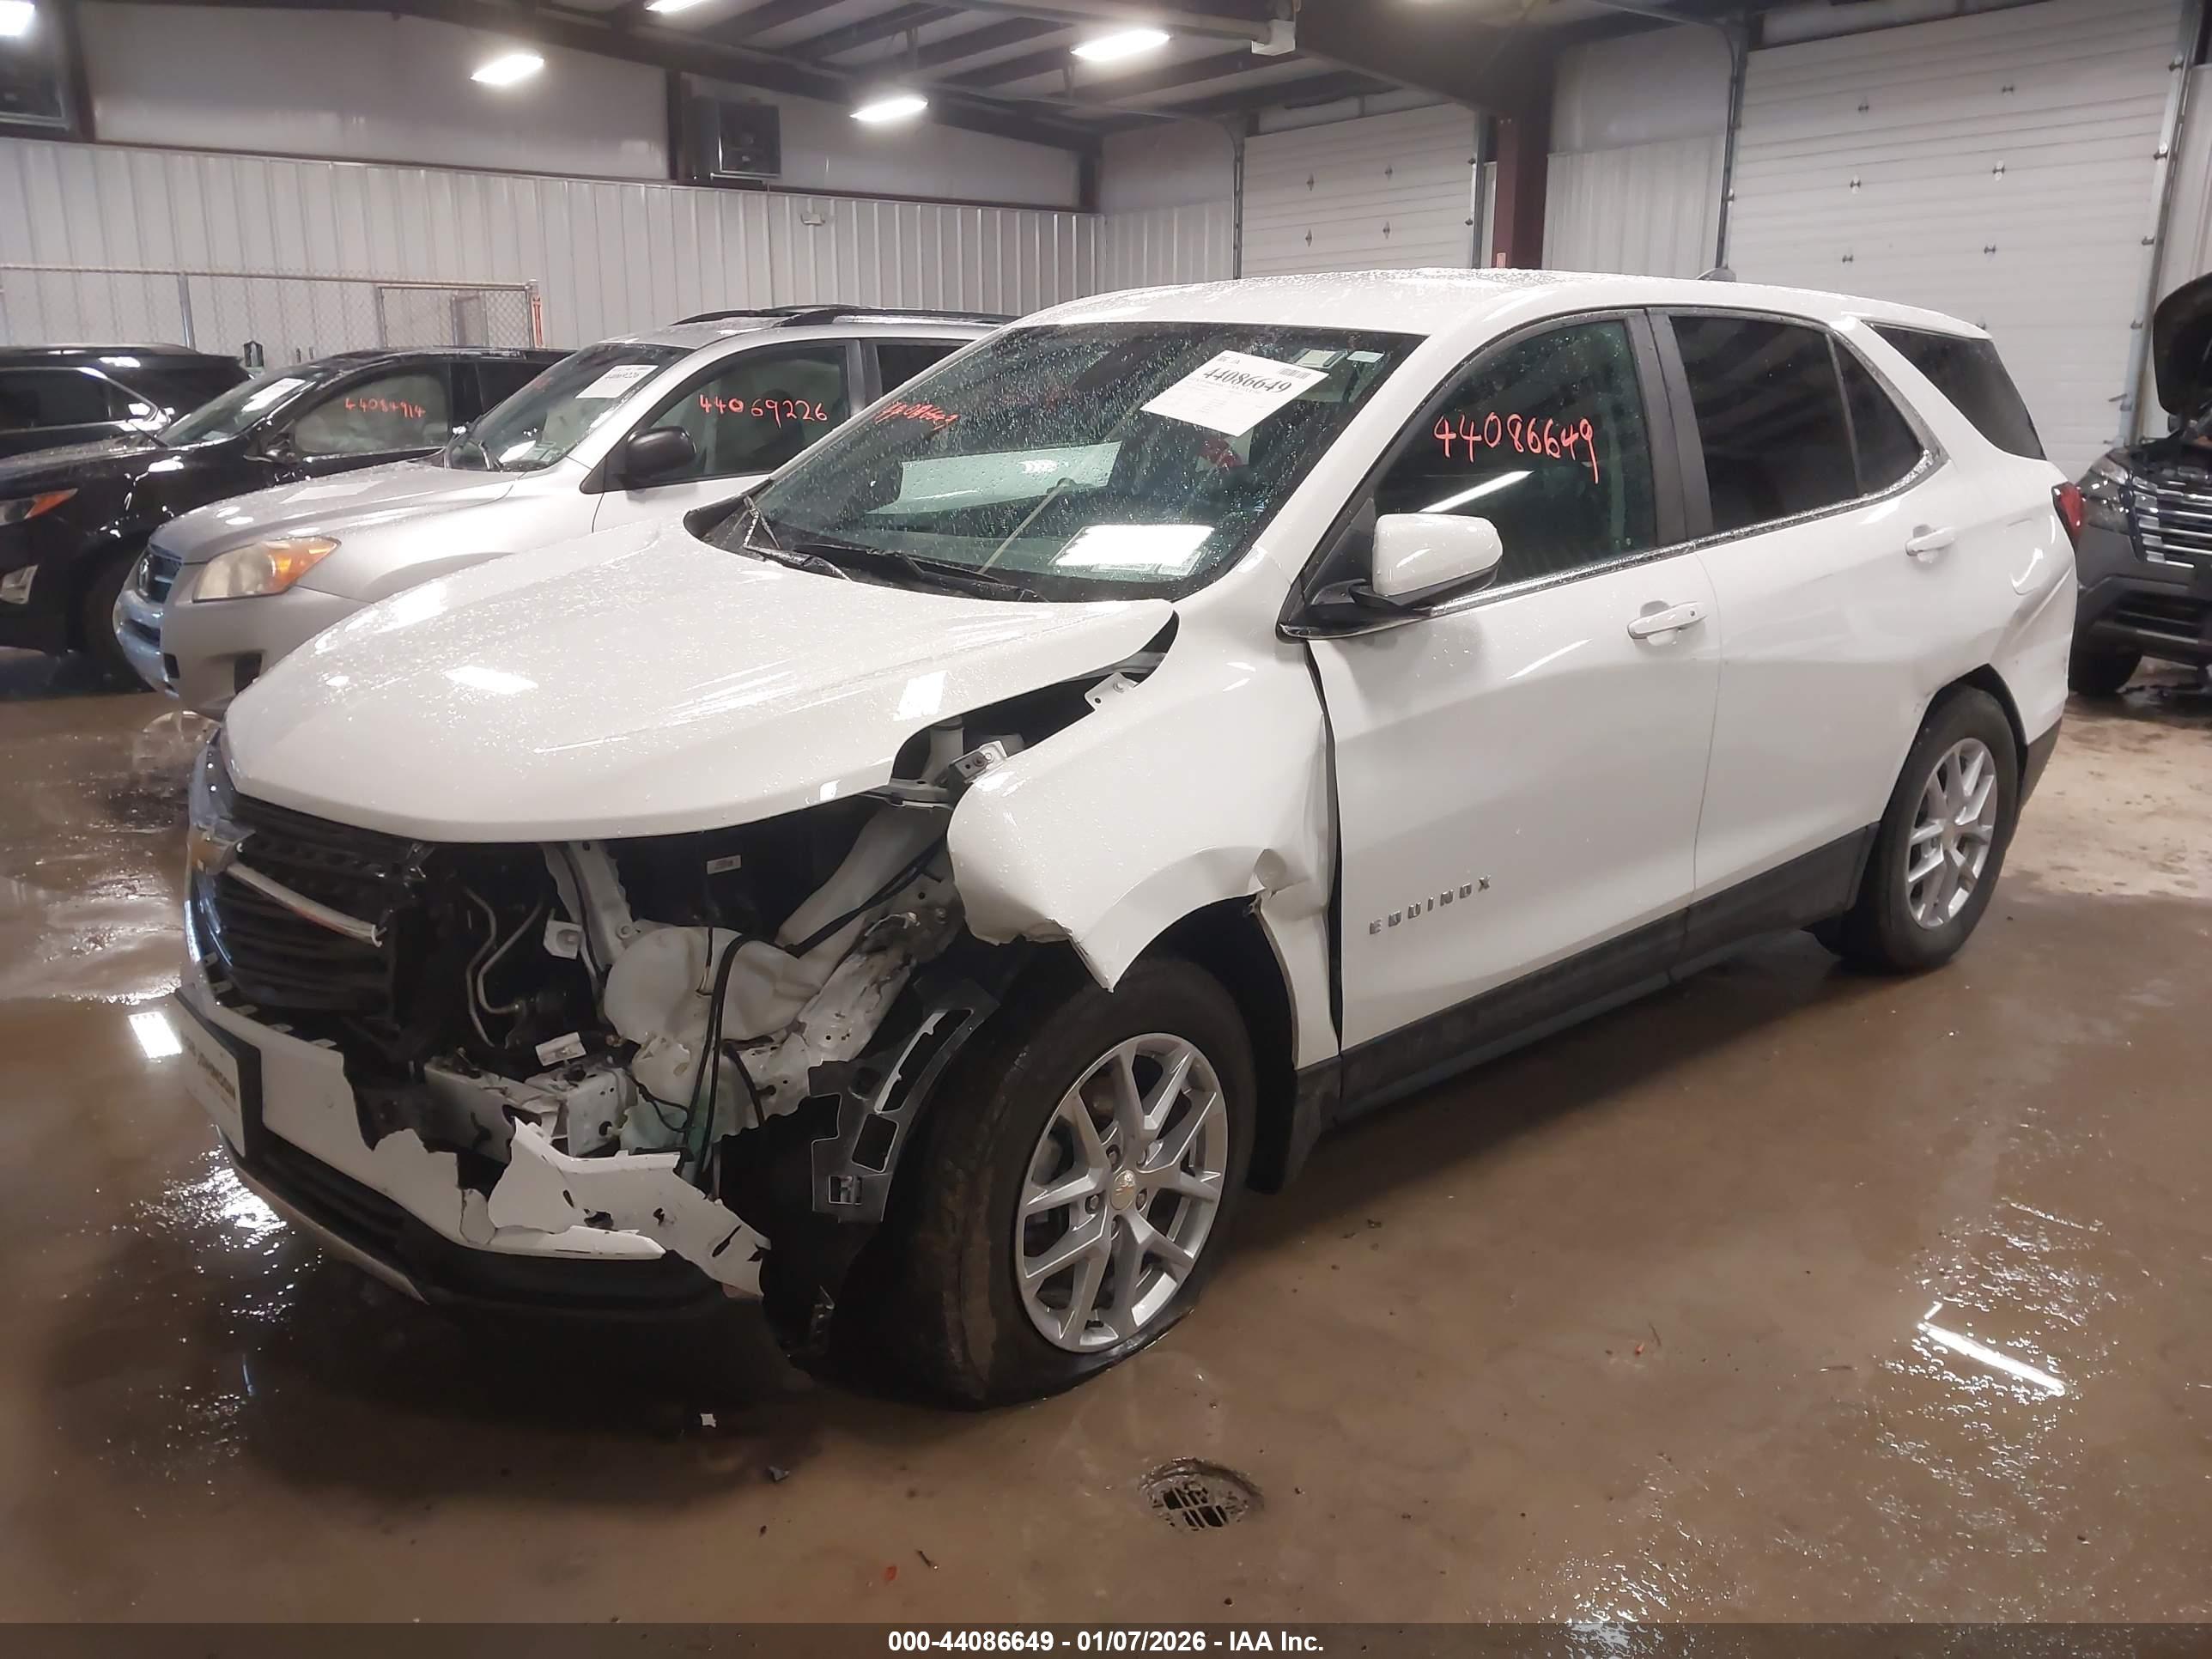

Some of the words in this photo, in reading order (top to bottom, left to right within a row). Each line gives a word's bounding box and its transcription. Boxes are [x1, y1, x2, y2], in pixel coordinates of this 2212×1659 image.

[1203, 367, 1292, 393] 44086649
[699, 393, 828, 428] 44069226
[1433, 411, 1599, 484] 44086649
[1369, 874, 1492, 935] EQUINOX
